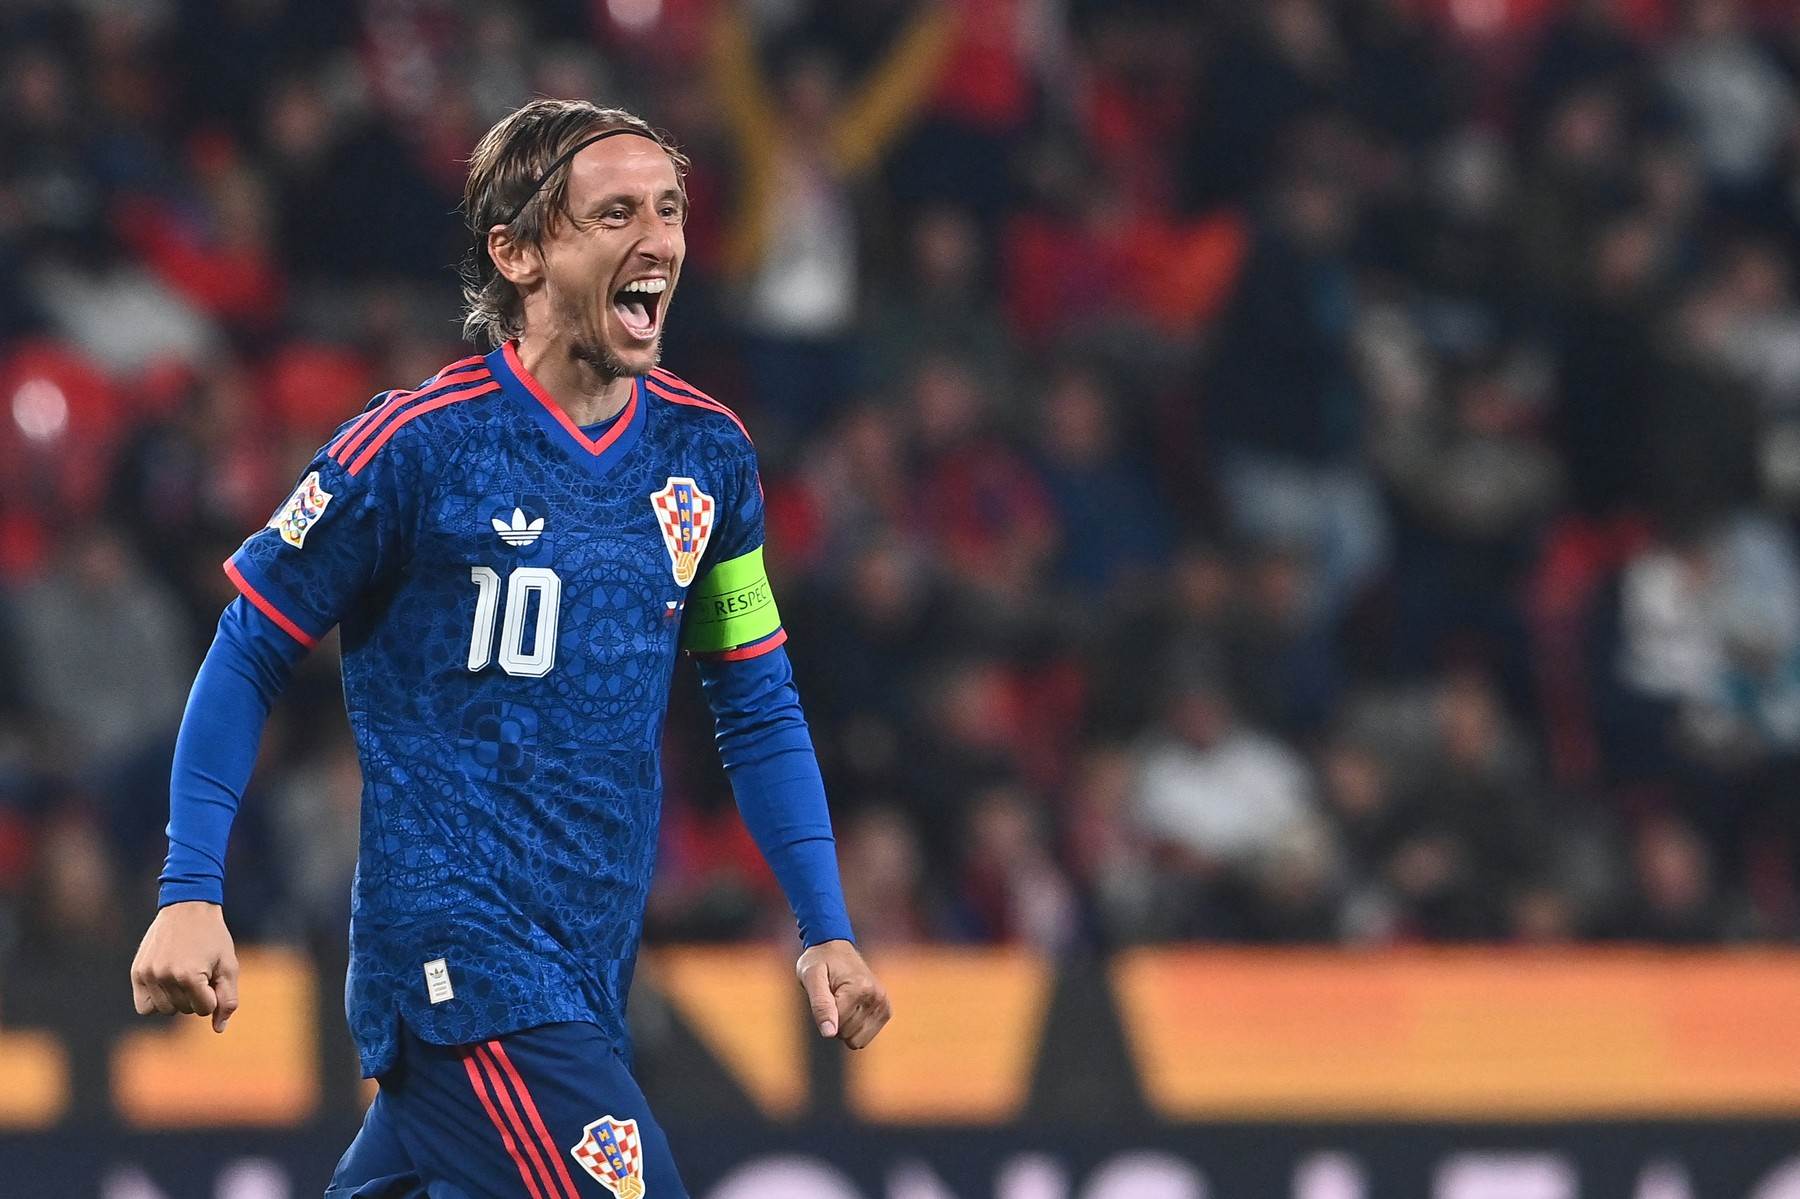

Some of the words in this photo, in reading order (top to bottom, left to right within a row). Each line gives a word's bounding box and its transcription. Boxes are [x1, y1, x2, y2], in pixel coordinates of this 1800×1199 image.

[678, 490, 691, 542] HNS
[467, 566, 561, 678] 10
[714, 582, 768, 616] RESPEC
[597, 1128, 624, 1170] HNS
